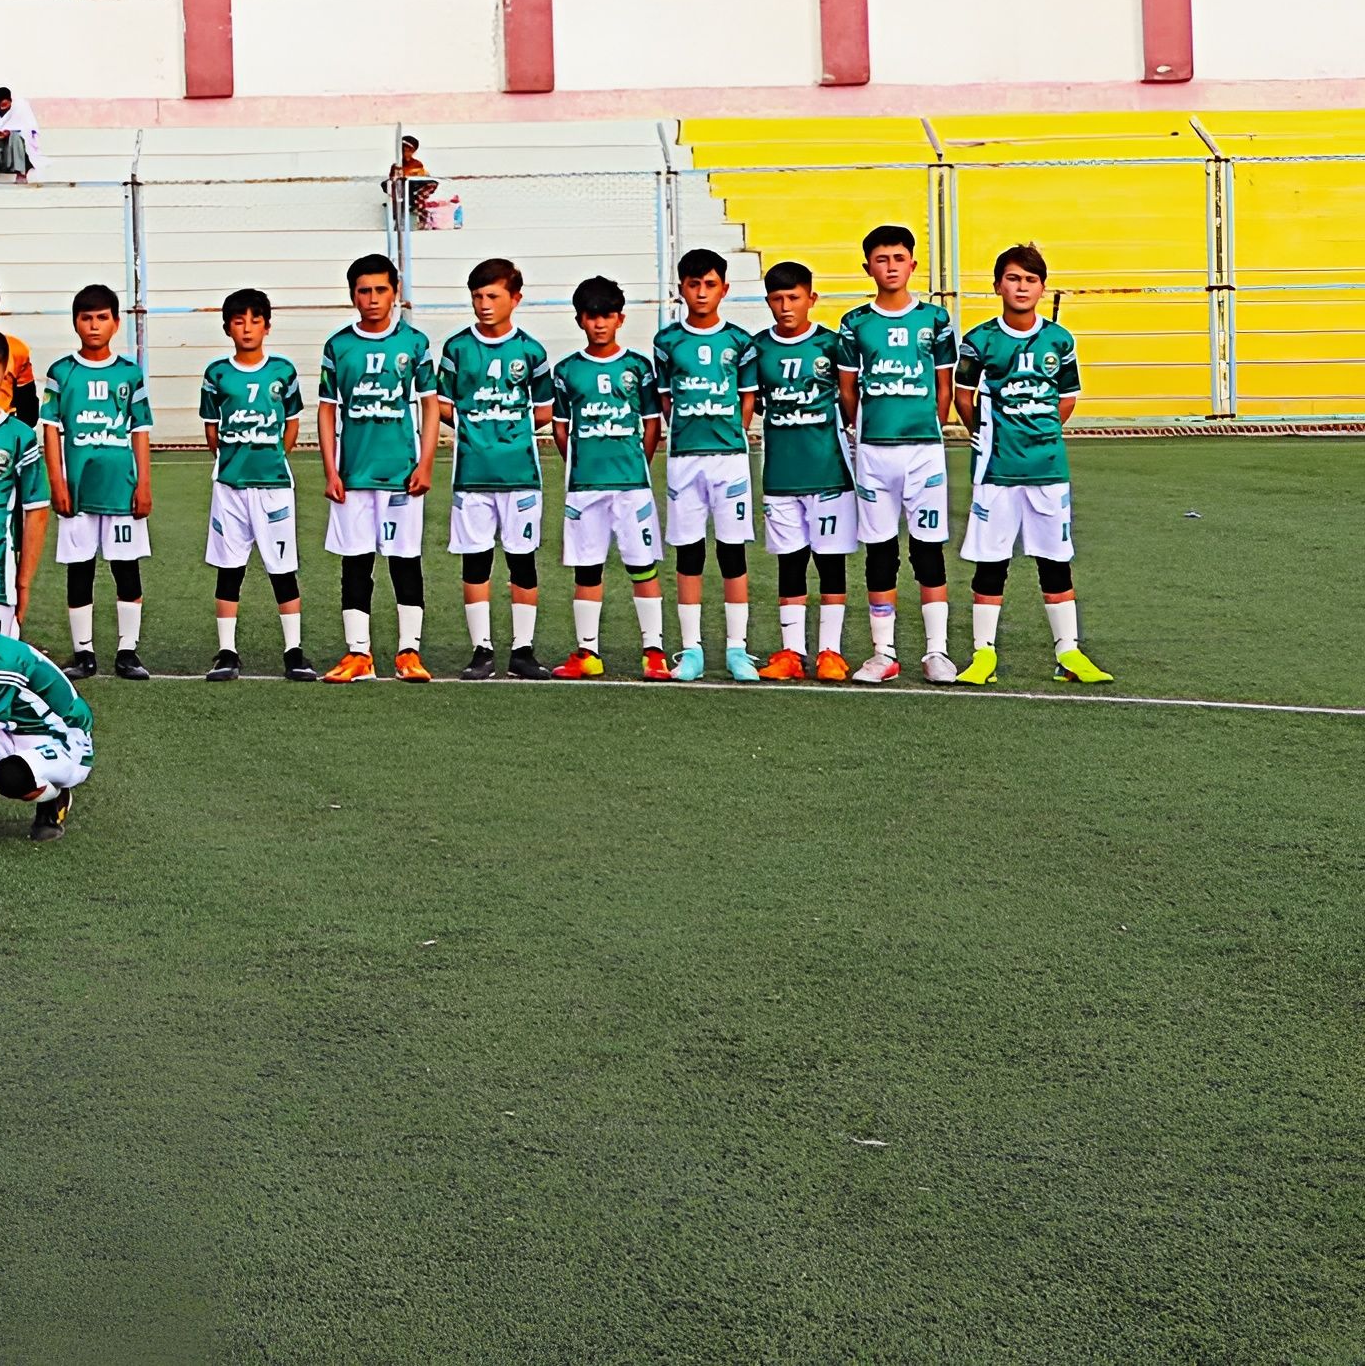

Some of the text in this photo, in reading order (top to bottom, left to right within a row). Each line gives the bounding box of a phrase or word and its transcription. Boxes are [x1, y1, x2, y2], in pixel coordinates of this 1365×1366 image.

[887, 327, 909, 347] 20
[365, 352, 386, 374] 17
[697, 345, 712, 365] 9
[486, 358, 502, 379] 4
[780, 357, 802, 378] 77
[87, 380, 109, 401] 10
[246, 383, 260, 403] 7
[596, 373, 612, 394] 6
[736, 501, 745, 521] 9
[918, 509, 939, 529] 20
[114, 524, 132, 543] 10
[382, 521, 397, 541] 17
[818, 515, 837, 536] 77
[642, 527, 652, 546] 6
[276, 540, 286, 559] 7
